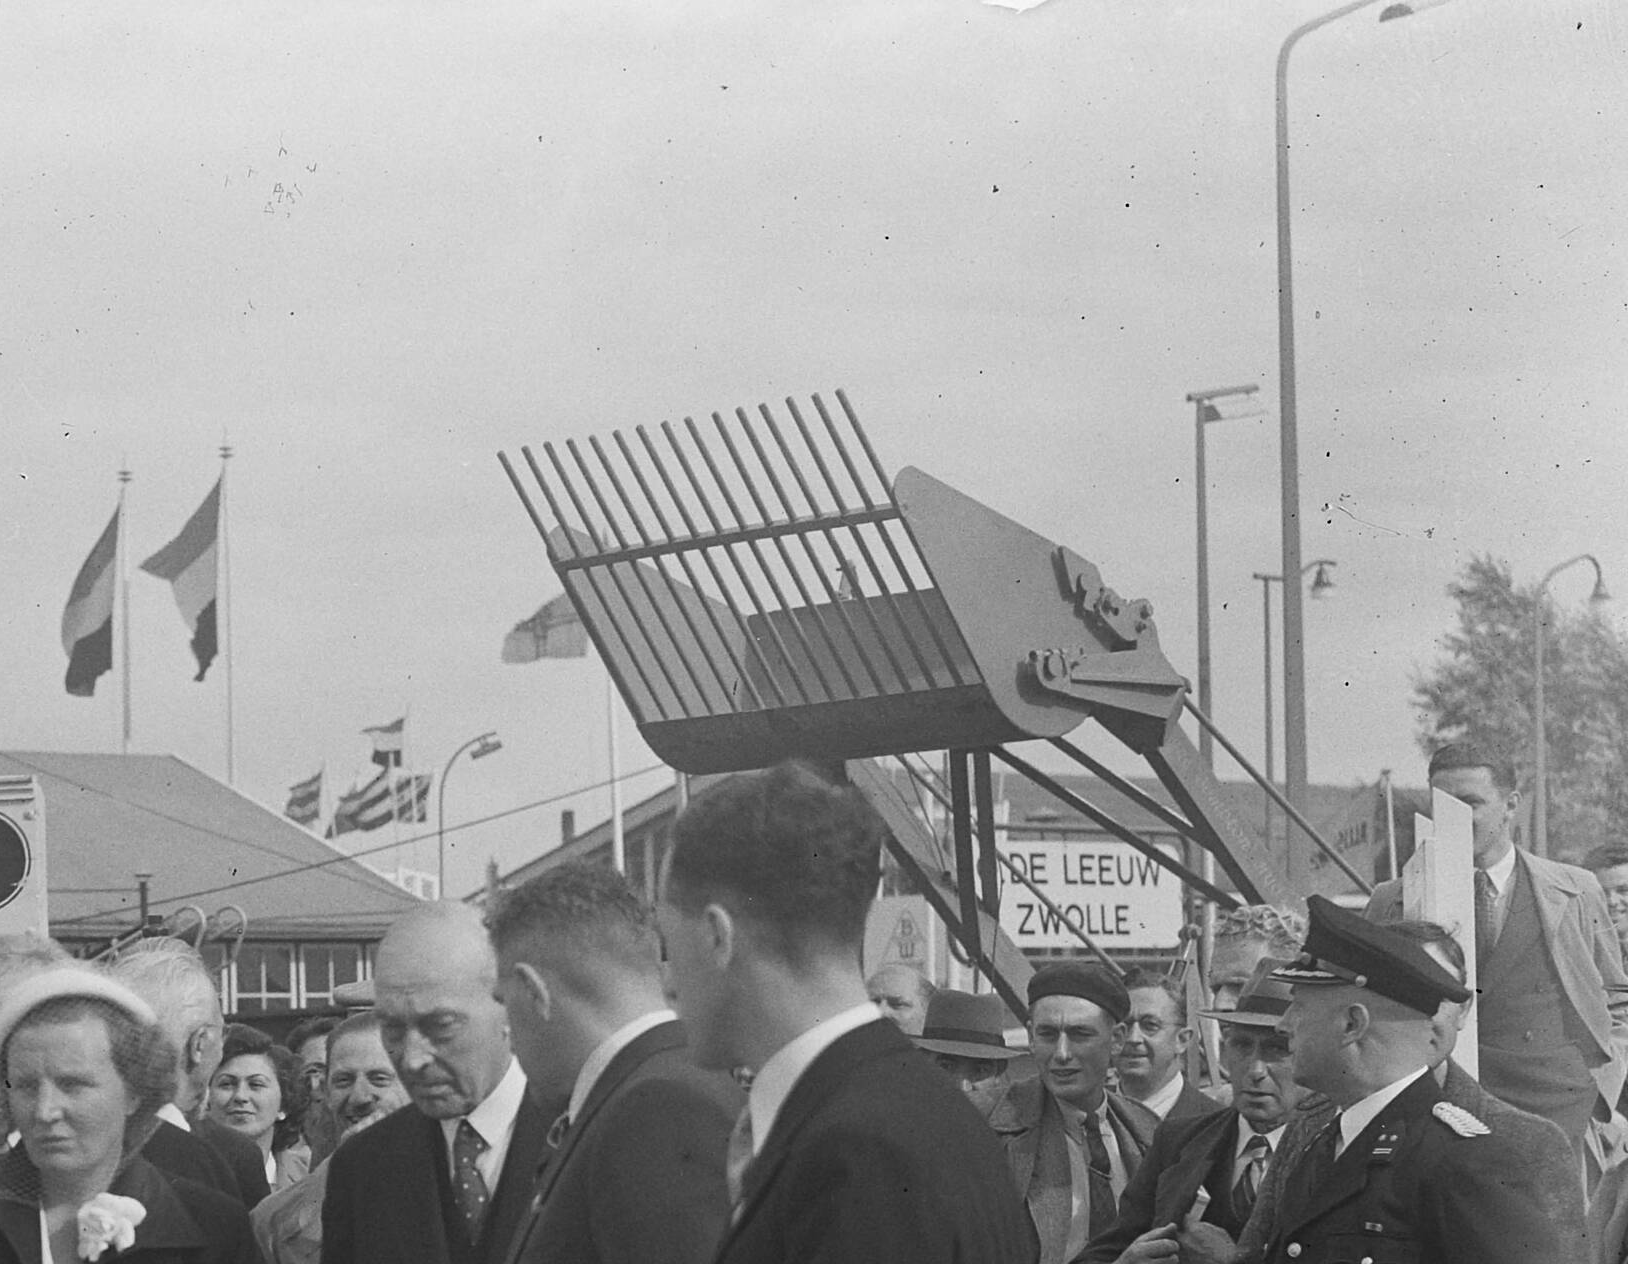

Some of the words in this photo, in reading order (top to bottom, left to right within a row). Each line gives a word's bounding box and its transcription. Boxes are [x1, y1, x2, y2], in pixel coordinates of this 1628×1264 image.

[1009, 852, 1049, 885] DE
[1063, 853, 1161, 887] LEEUW
[1015, 903, 1131, 936] ZWOLLE
